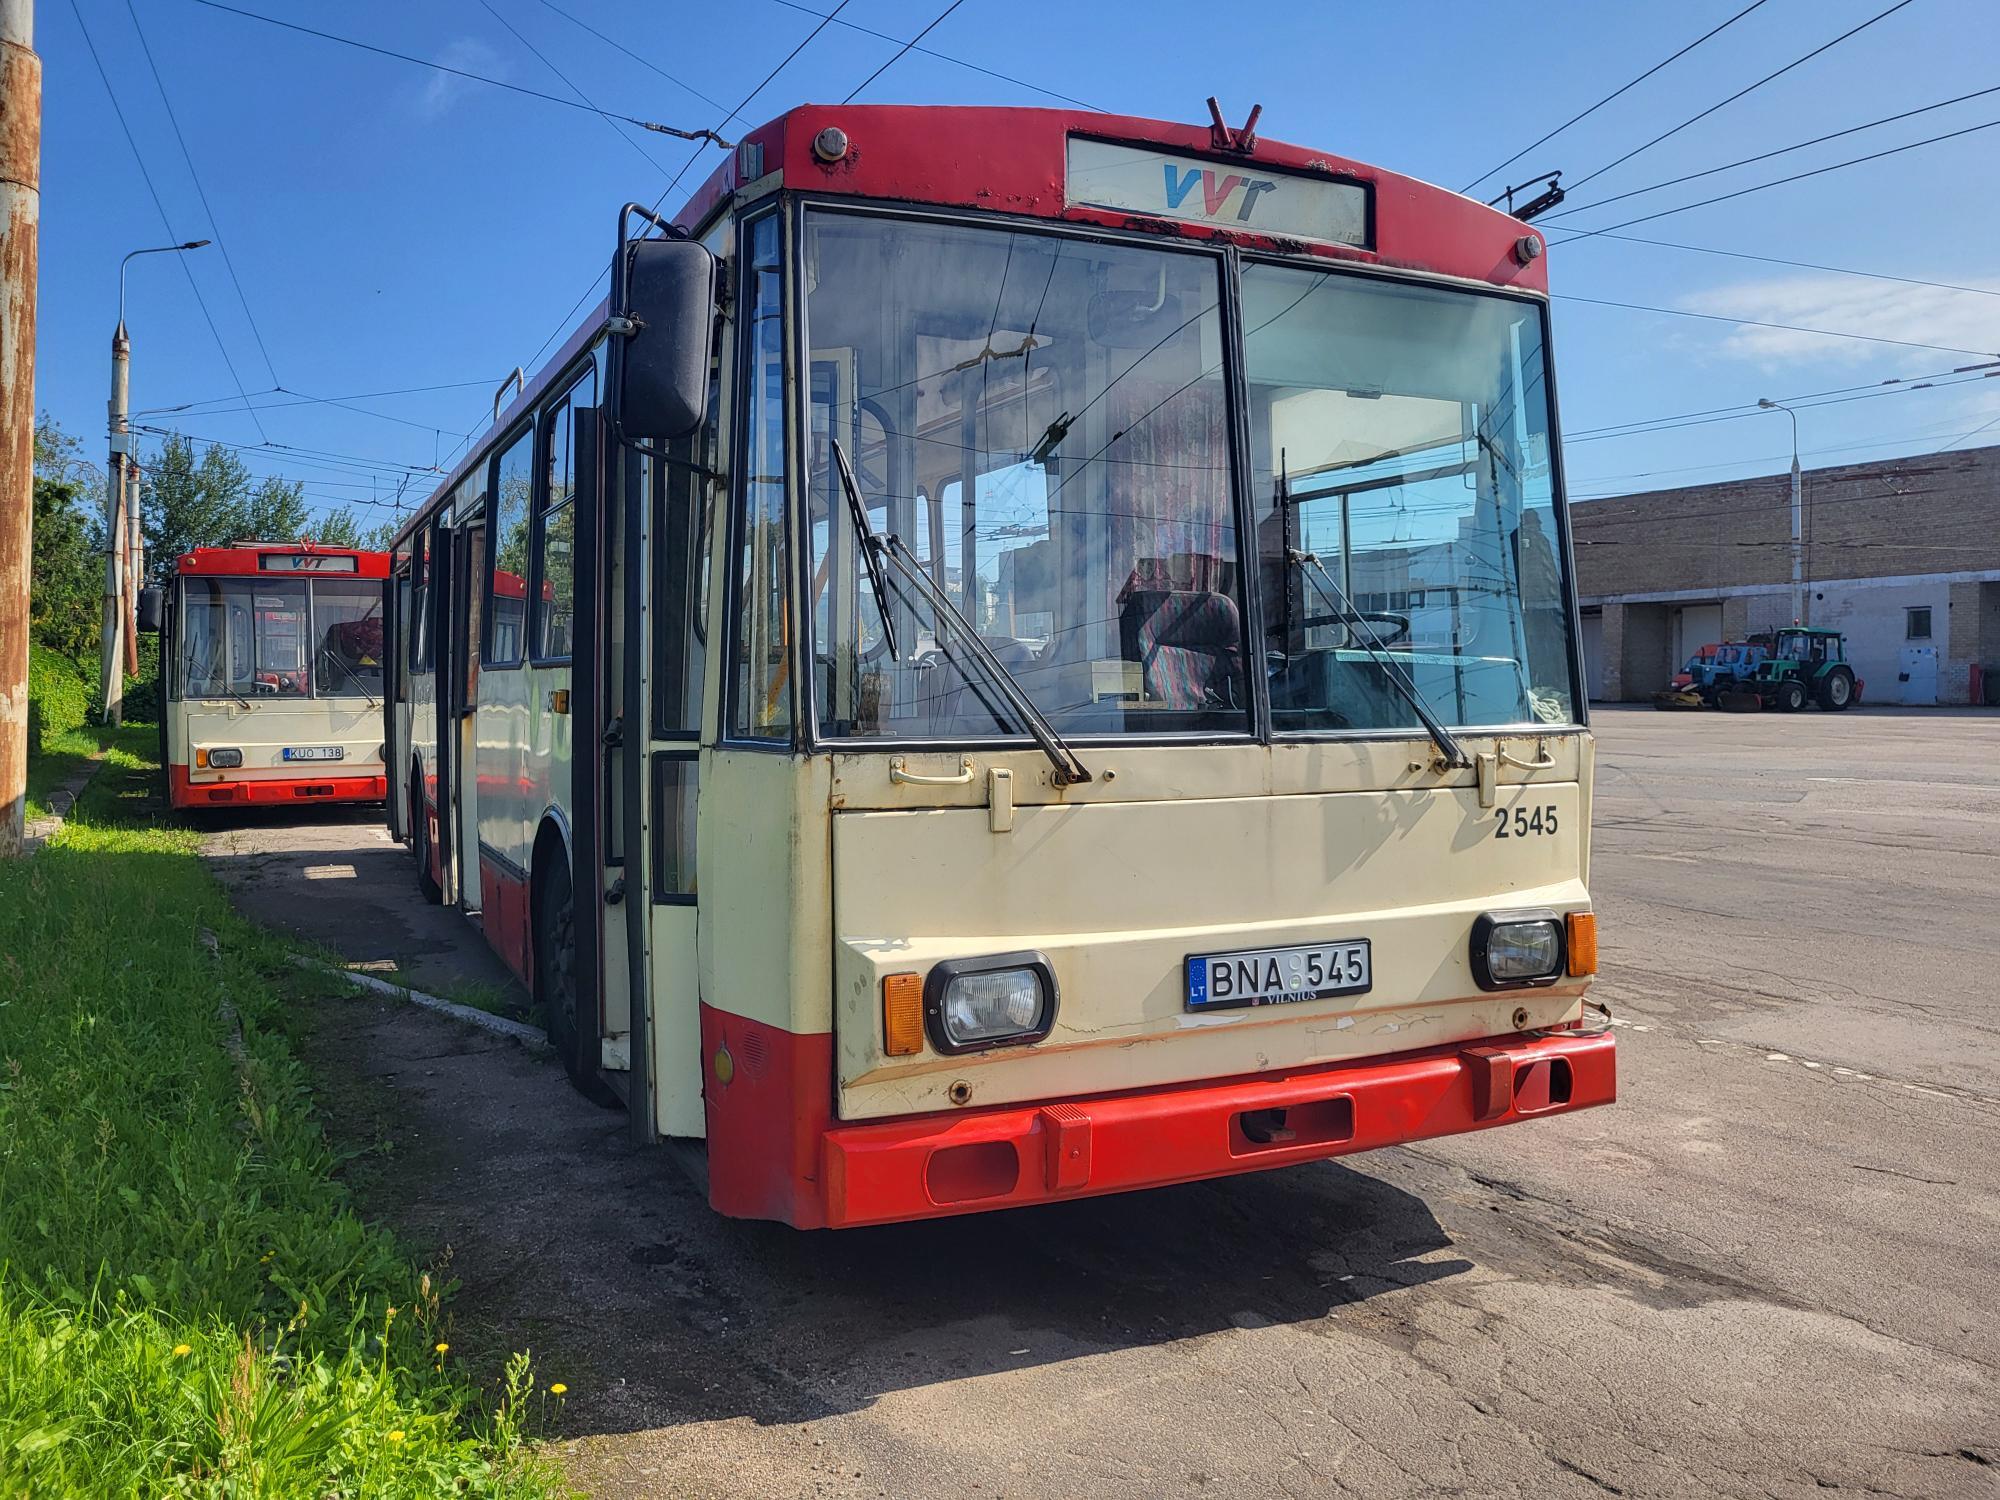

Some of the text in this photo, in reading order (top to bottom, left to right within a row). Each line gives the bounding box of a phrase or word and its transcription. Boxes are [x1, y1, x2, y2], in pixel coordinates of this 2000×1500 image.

[1164, 164, 1277, 221] VVT
[291, 557, 328, 568] VVT
[291, 749, 314, 758] KUO
[322, 748, 341, 758] 138
[1495, 805, 1558, 839] 2545
[1211, 949, 1363, 997] BNA 545
[1191, 985, 1206, 998] LT
[1266, 990, 1317, 1005] VILNIUS
